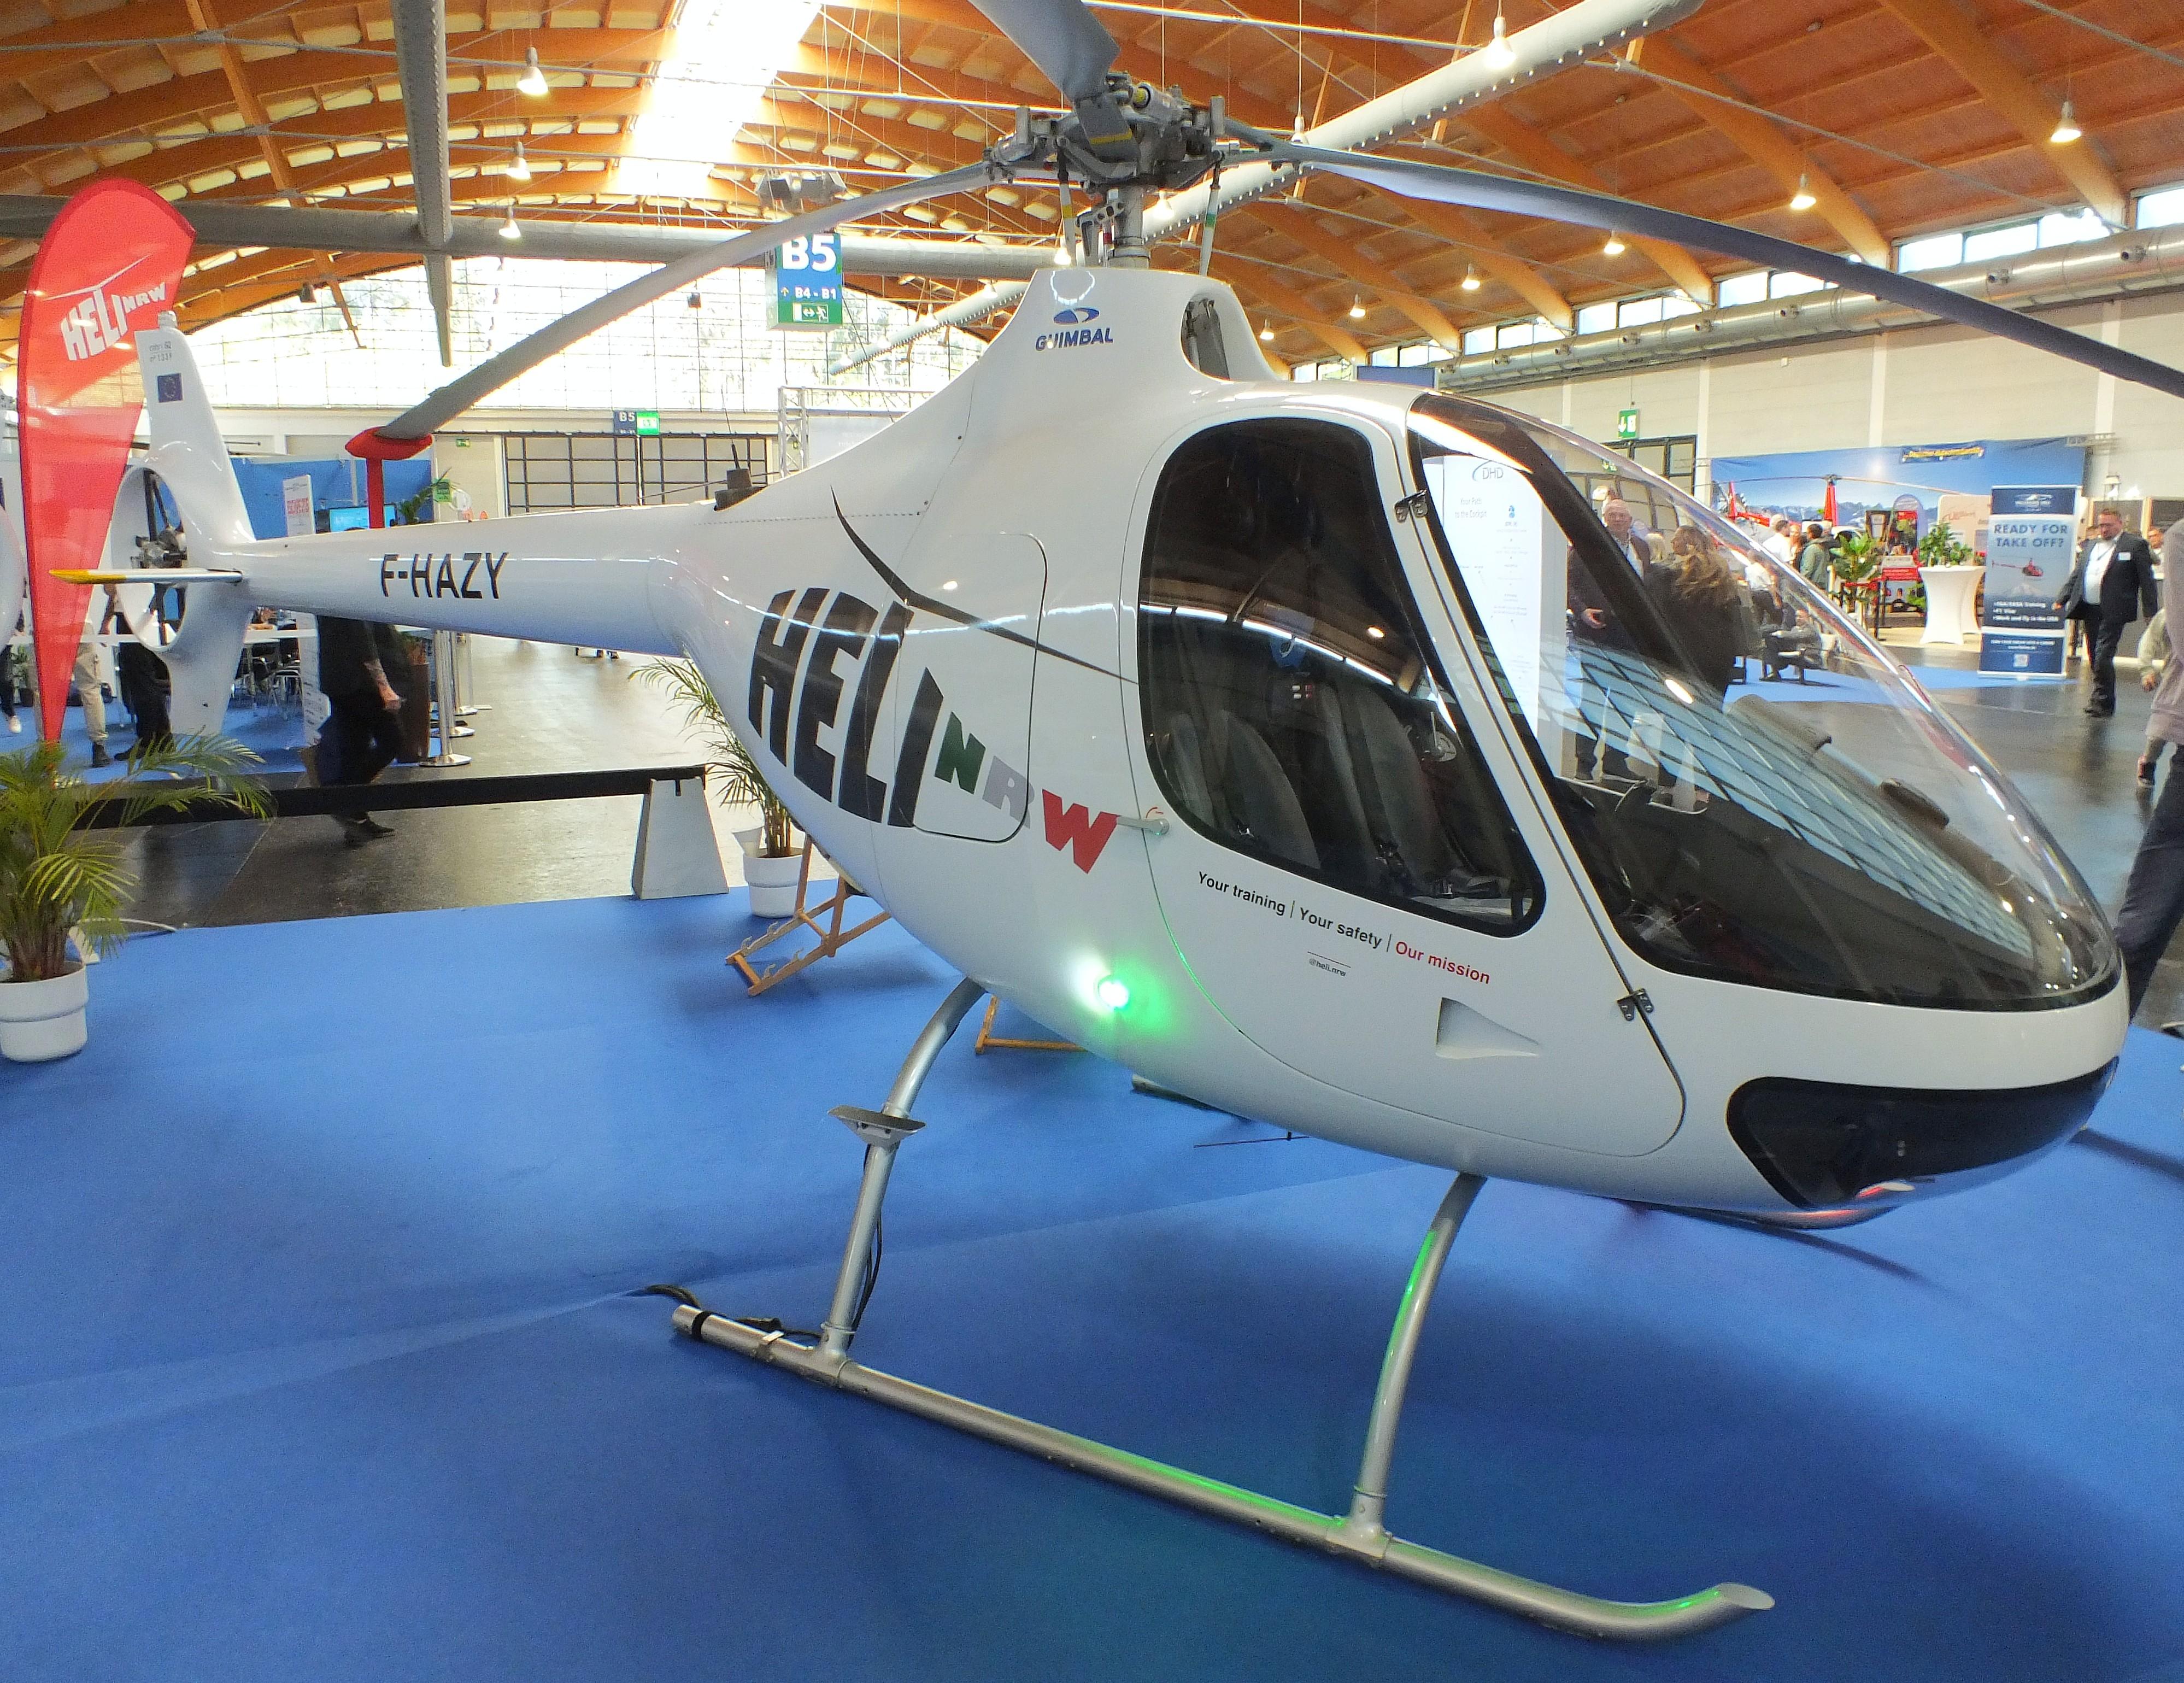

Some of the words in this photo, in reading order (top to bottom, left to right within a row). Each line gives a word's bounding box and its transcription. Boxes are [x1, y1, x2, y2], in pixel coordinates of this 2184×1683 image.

[782, 233, 836, 272] B5
[795, 286, 811, 298] B4
[821, 288, 837, 300] B1
[61, 288, 128, 361] HELI
[1035, 327, 1113, 351] GUIMBAL
[1482, 467, 1504, 479] DHD
[1994, 524, 2037, 533] READY
[2042, 524, 2068, 534] FOR
[1997, 538, 2028, 547] TAKE
[2033, 538, 2064, 547] OFF?
[381, 552, 509, 599] F-HAZY
[749, 587, 943, 828] HELI
[1198, 871, 1230, 893] Your
[1232, 884, 1286, 916] training
[1299, 907, 1334, 930] Your
[1337, 922, 1383, 950] safety
[1395, 940, 1424, 962] Our
[1428, 954, 1491, 984] mission
[1308, 958, 1346, 977] @heli.nrw
